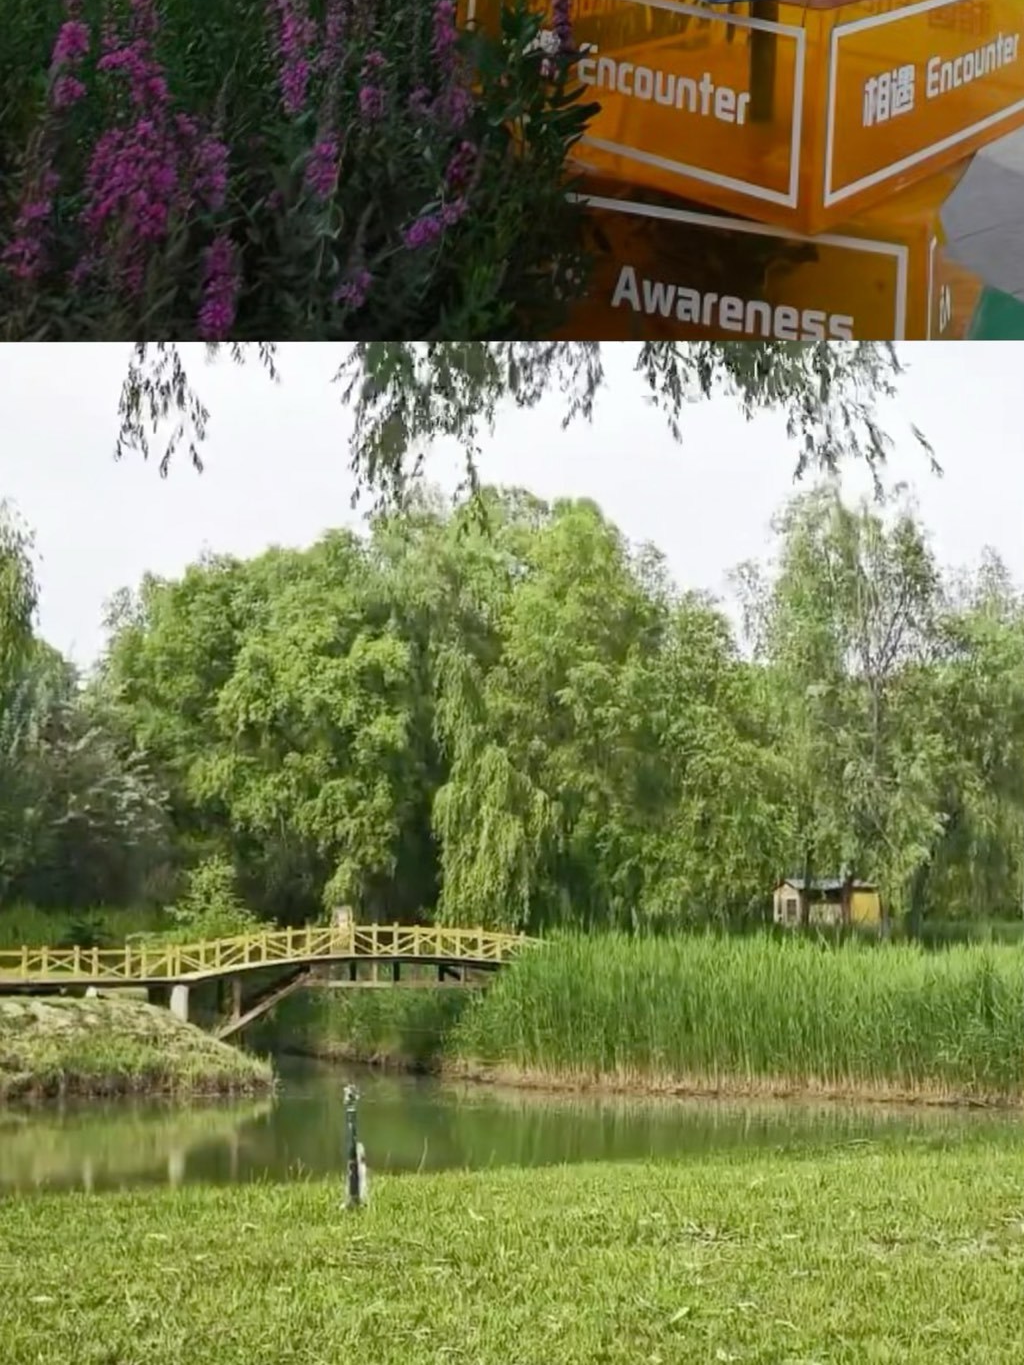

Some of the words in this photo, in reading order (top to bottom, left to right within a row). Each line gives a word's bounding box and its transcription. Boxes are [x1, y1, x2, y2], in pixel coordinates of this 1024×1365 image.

[577, 43, 751, 125] Encounter
[863, 64, 916, 128] 相遇
[926, 32, 1020, 99] Encounter
[611, 265, 855, 341] Awareness
